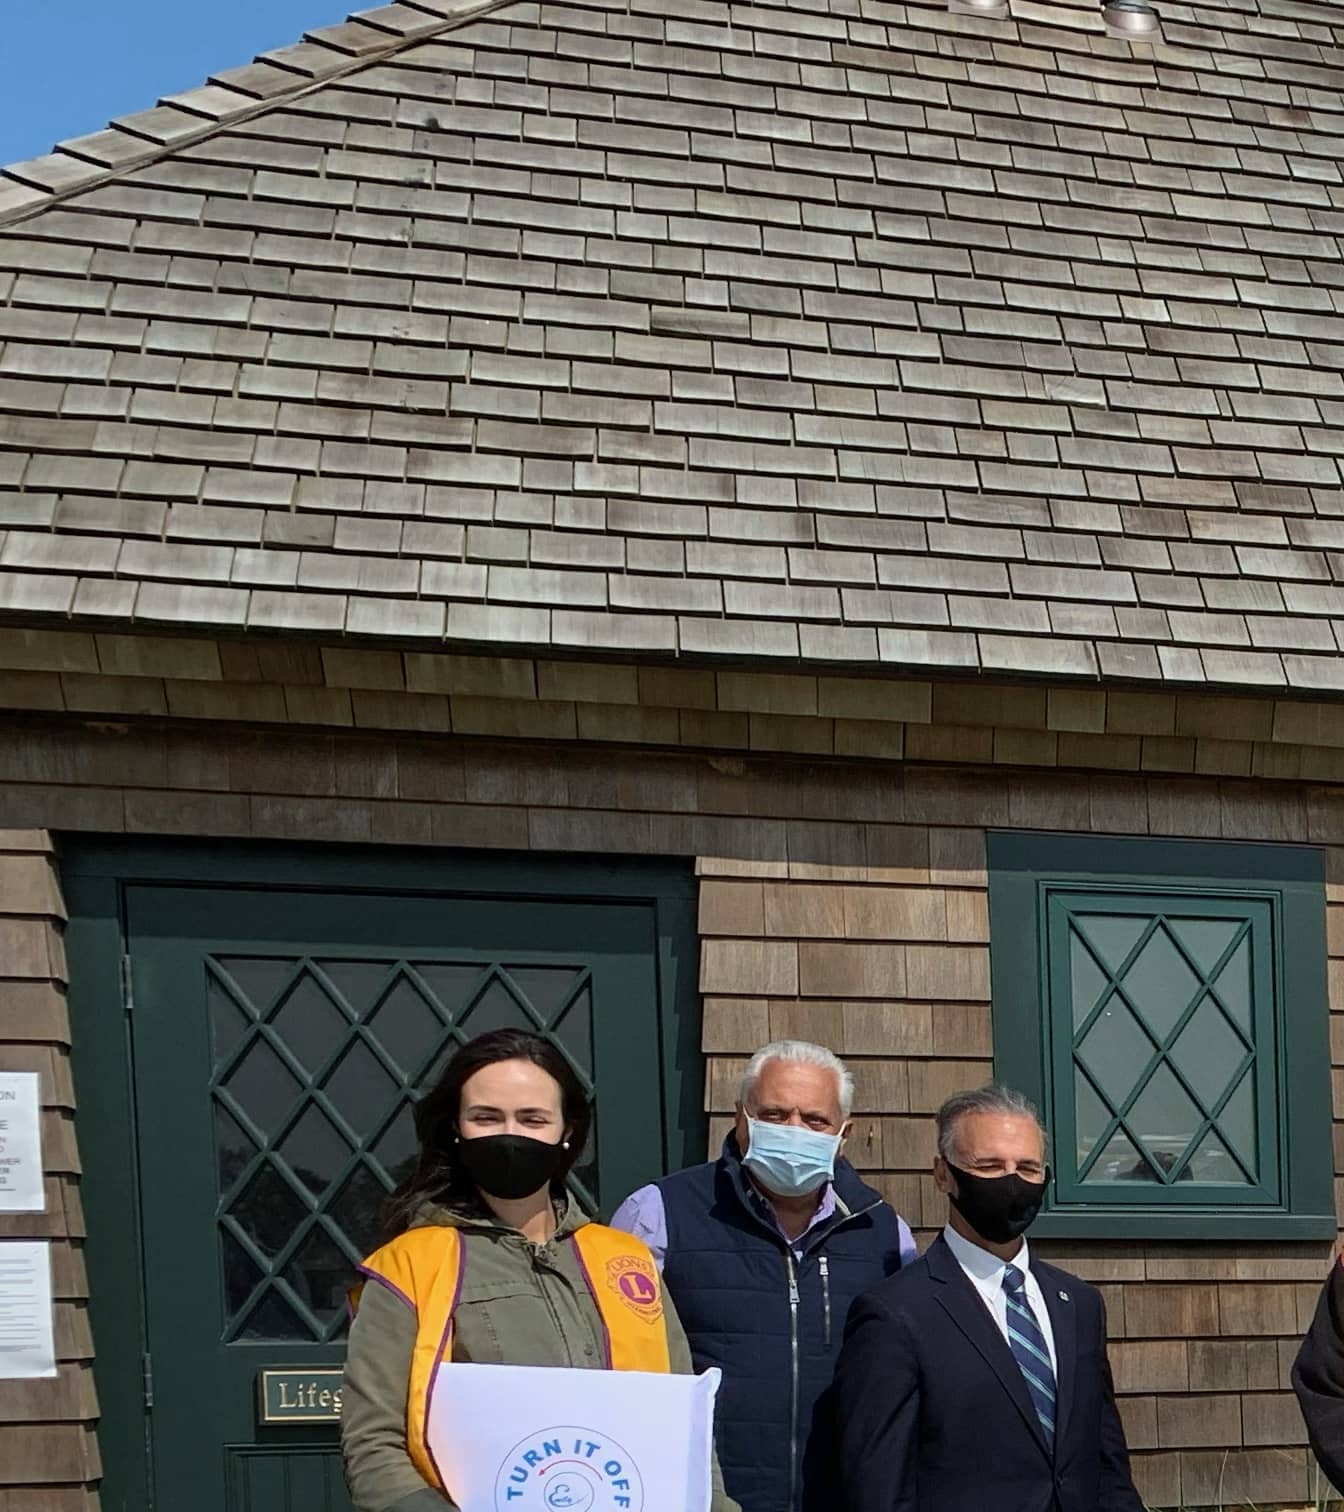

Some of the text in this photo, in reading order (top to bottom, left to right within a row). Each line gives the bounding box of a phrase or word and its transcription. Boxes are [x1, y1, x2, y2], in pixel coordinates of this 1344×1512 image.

[622, 1274, 654, 1300] L
[506, 1438, 631, 1509] TURN IT OFF
